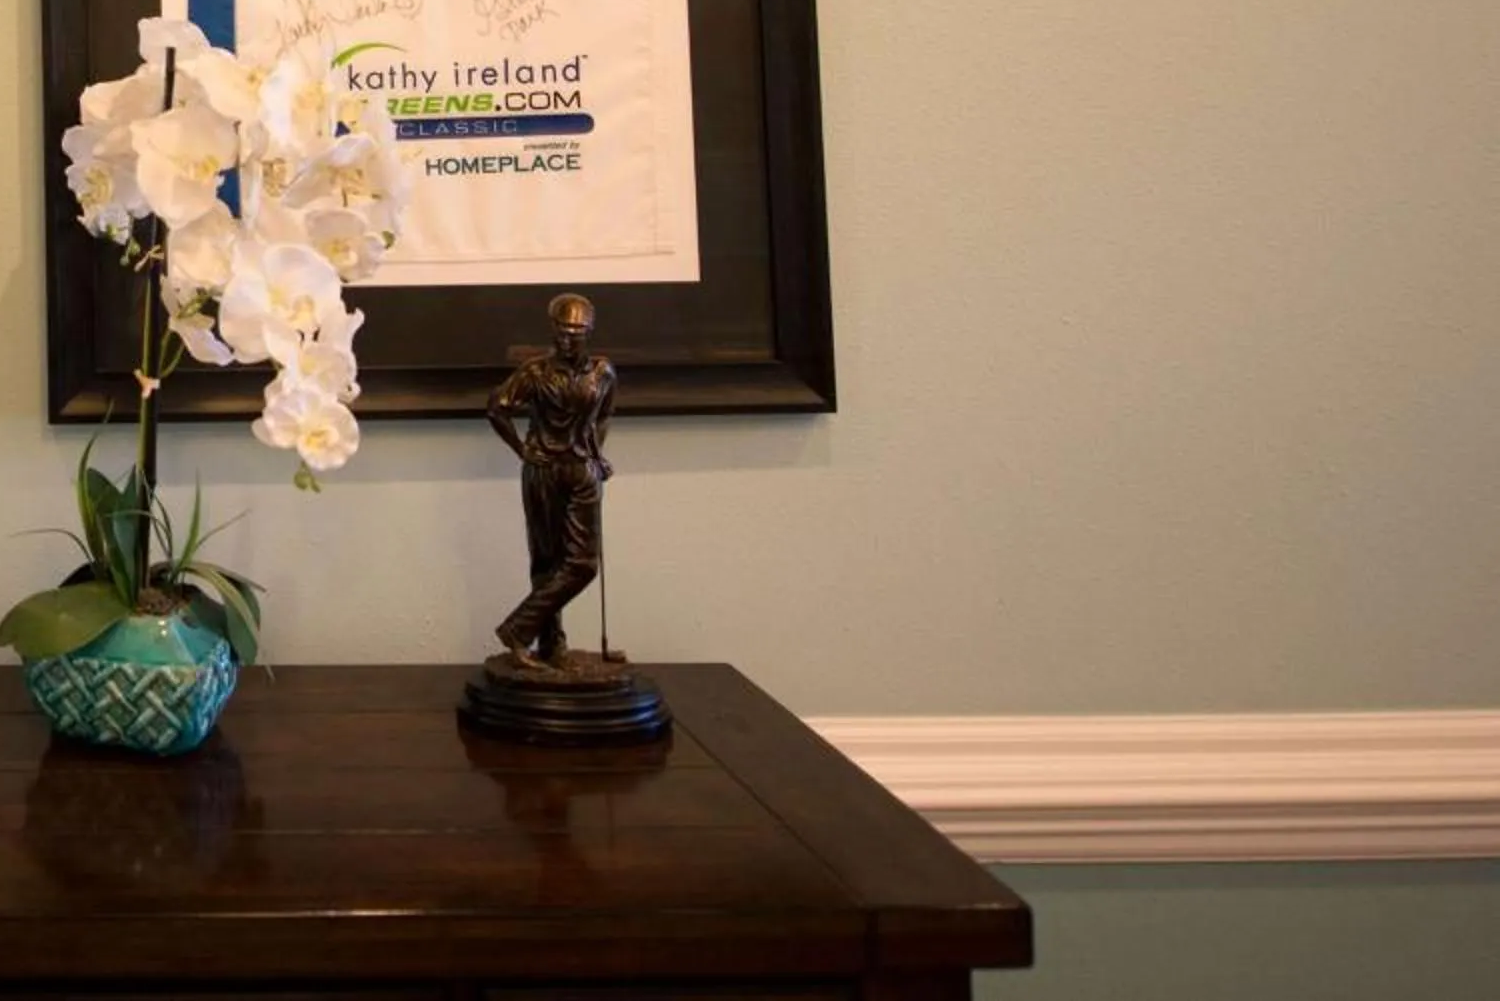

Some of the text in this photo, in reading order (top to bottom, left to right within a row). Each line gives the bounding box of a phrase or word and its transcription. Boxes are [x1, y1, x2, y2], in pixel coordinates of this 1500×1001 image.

[348, 55, 581, 93] kathy ireland
[387, 90, 582, 116] REENS.COM
[399, 119, 519, 137] CLASSIC
[425, 153, 582, 177] HOMEPLACE
